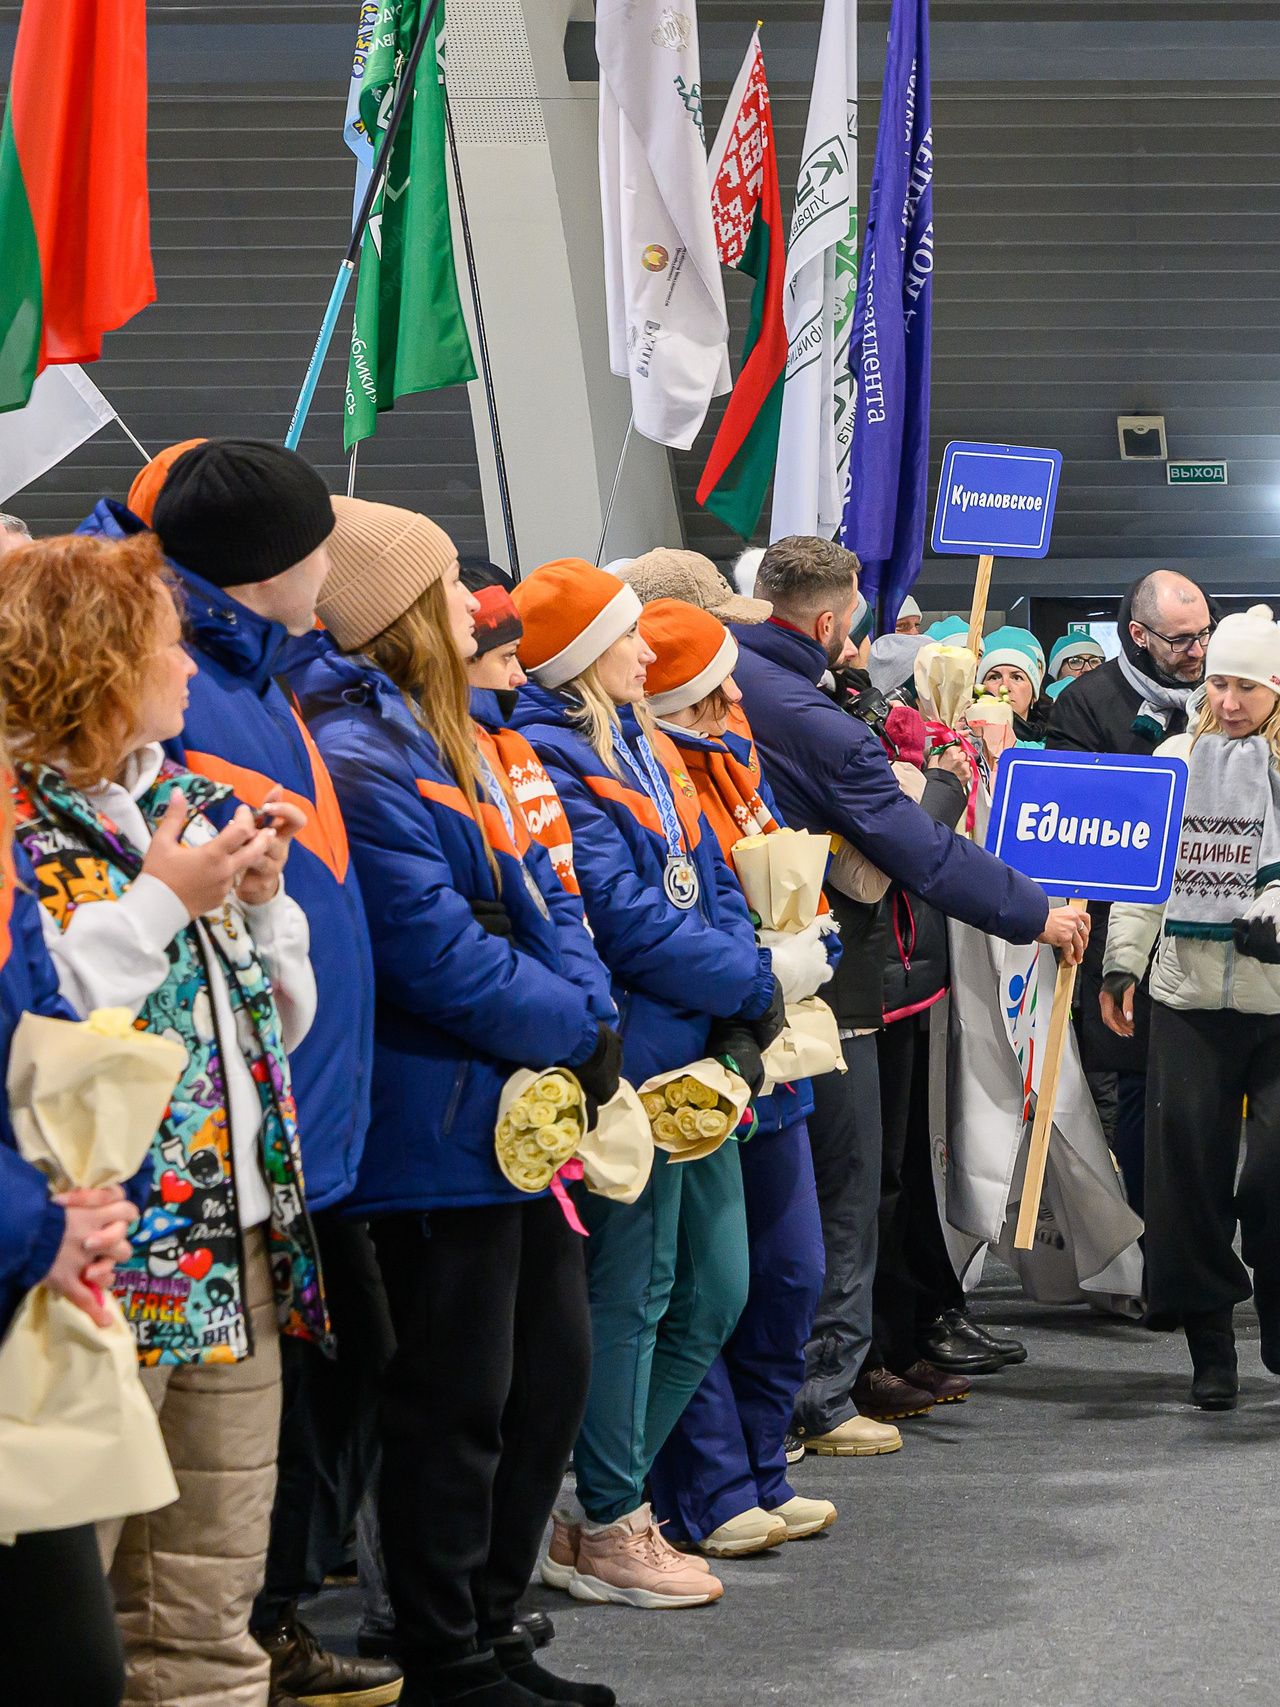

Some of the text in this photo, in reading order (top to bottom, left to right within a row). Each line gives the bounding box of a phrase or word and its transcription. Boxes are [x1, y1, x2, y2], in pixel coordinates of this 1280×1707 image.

[1170, 467, 1224, 480] ВЫХОД
[951, 484, 1043, 512] Купаловское
[1016, 801, 1151, 850] Единые
[1180, 841, 1252, 864] ЕДИНЫЕ
